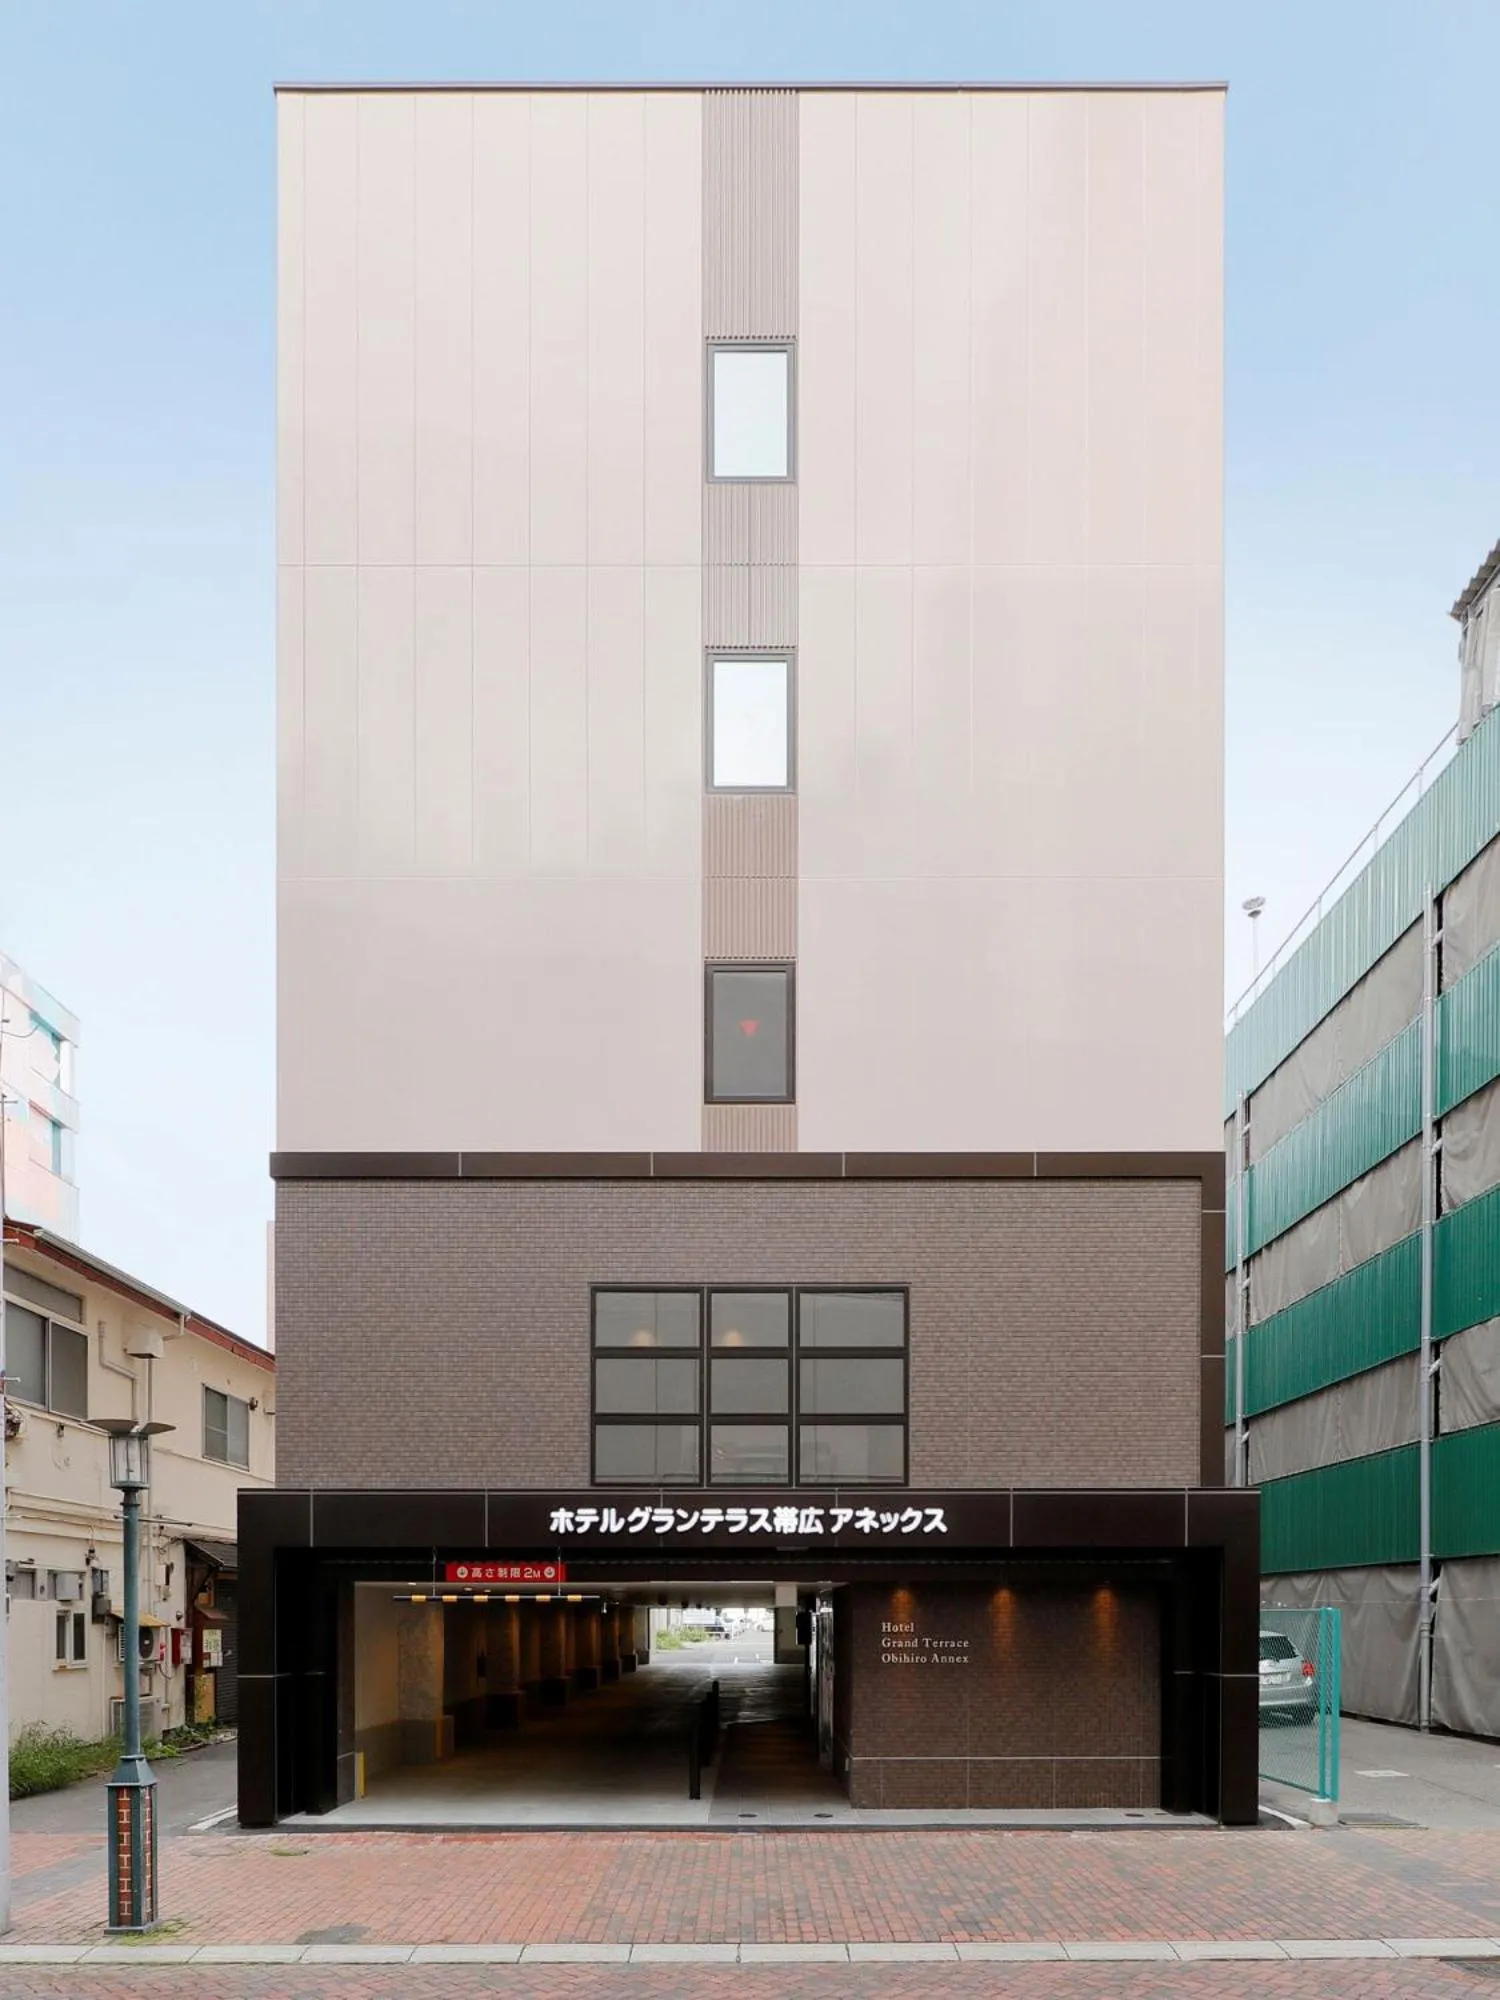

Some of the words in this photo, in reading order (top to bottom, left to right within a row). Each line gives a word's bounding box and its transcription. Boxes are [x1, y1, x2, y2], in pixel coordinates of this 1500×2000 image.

[881, 1621, 915, 1633] Hotel
[881, 1637, 919, 1648] Grand
[922, 1637, 970, 1648] Terrace
[881, 1652, 928, 1664] Obihiro
[931, 1652, 970, 1664] Annex
